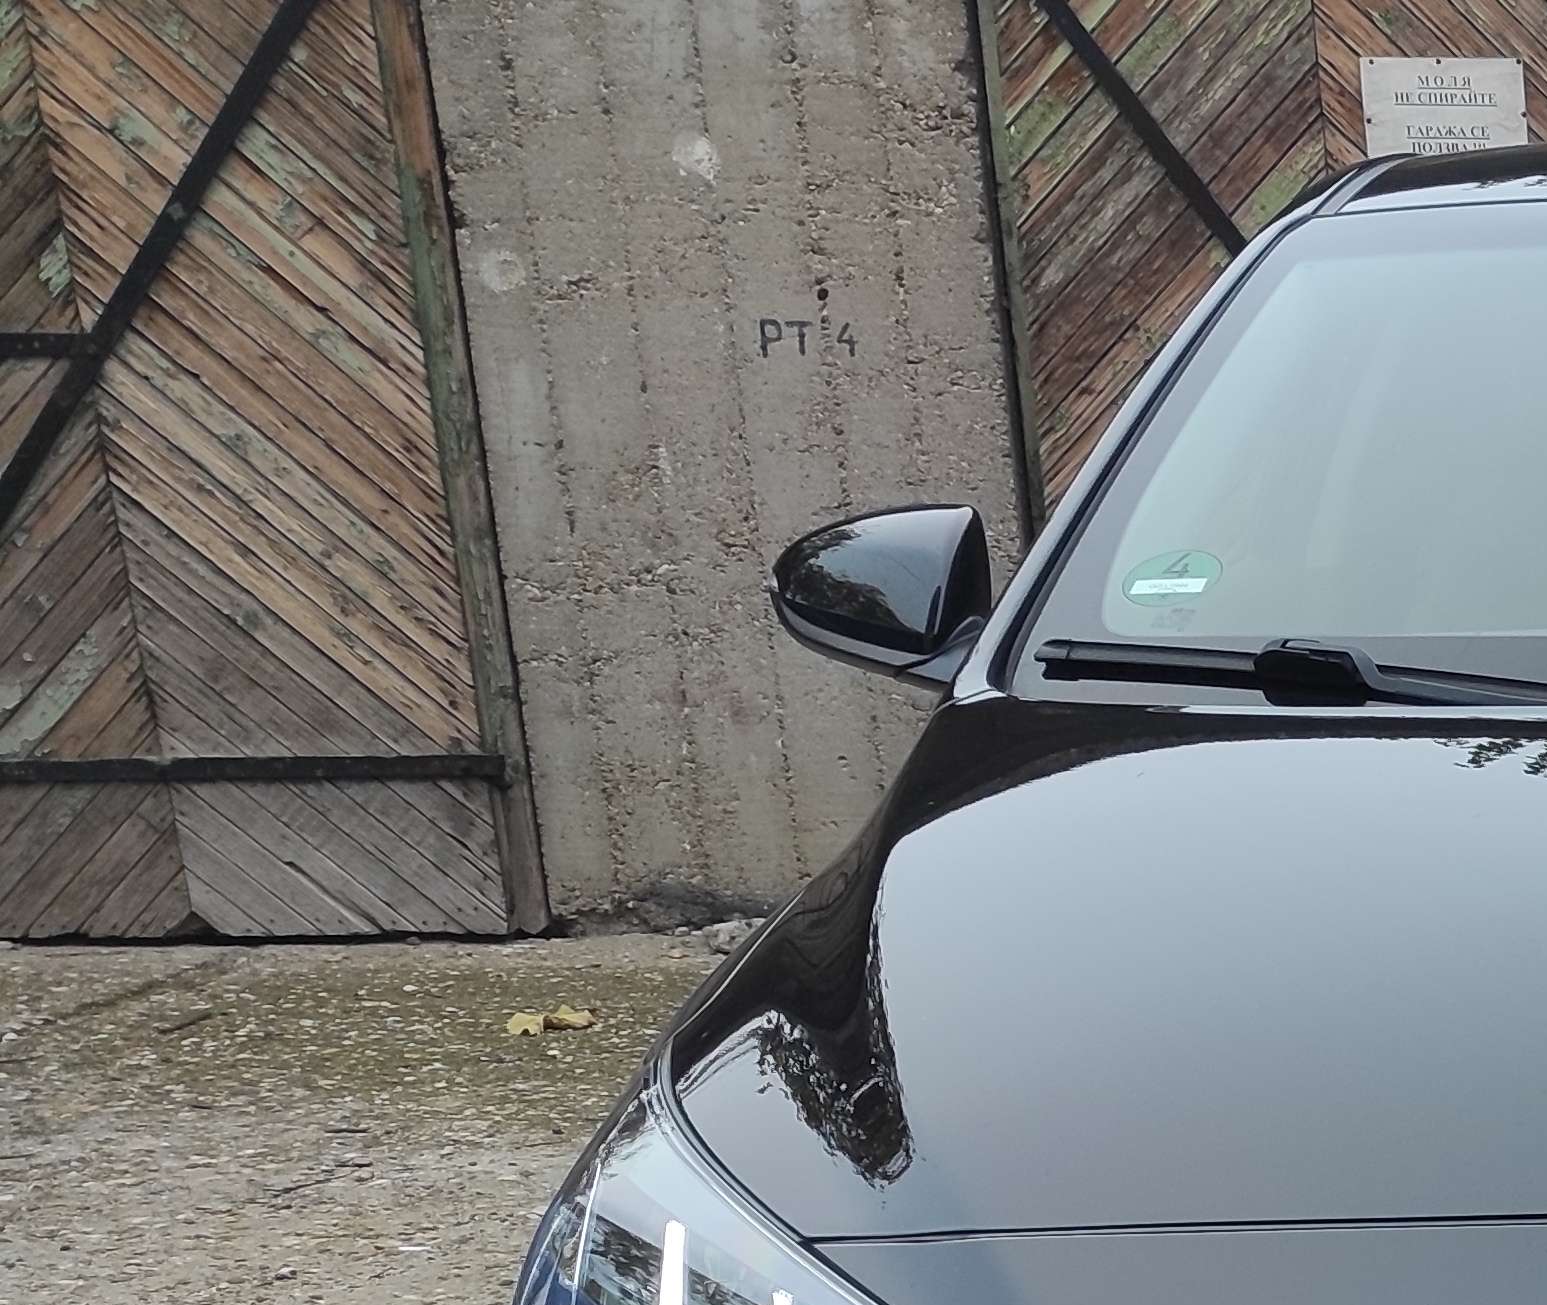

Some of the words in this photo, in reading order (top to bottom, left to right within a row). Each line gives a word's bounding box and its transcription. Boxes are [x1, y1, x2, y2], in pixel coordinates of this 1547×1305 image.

[1417, 75, 1472, 87] МОЛЯ
[1394, 91, 1413, 104] НЕ
[1417, 91, 1497, 105] СПИРАЙТЕ
[1406, 125, 1467, 137] ГАРАЖА
[1470, 126, 1490, 138] СЕ
[836, 322, 858, 357] 4
